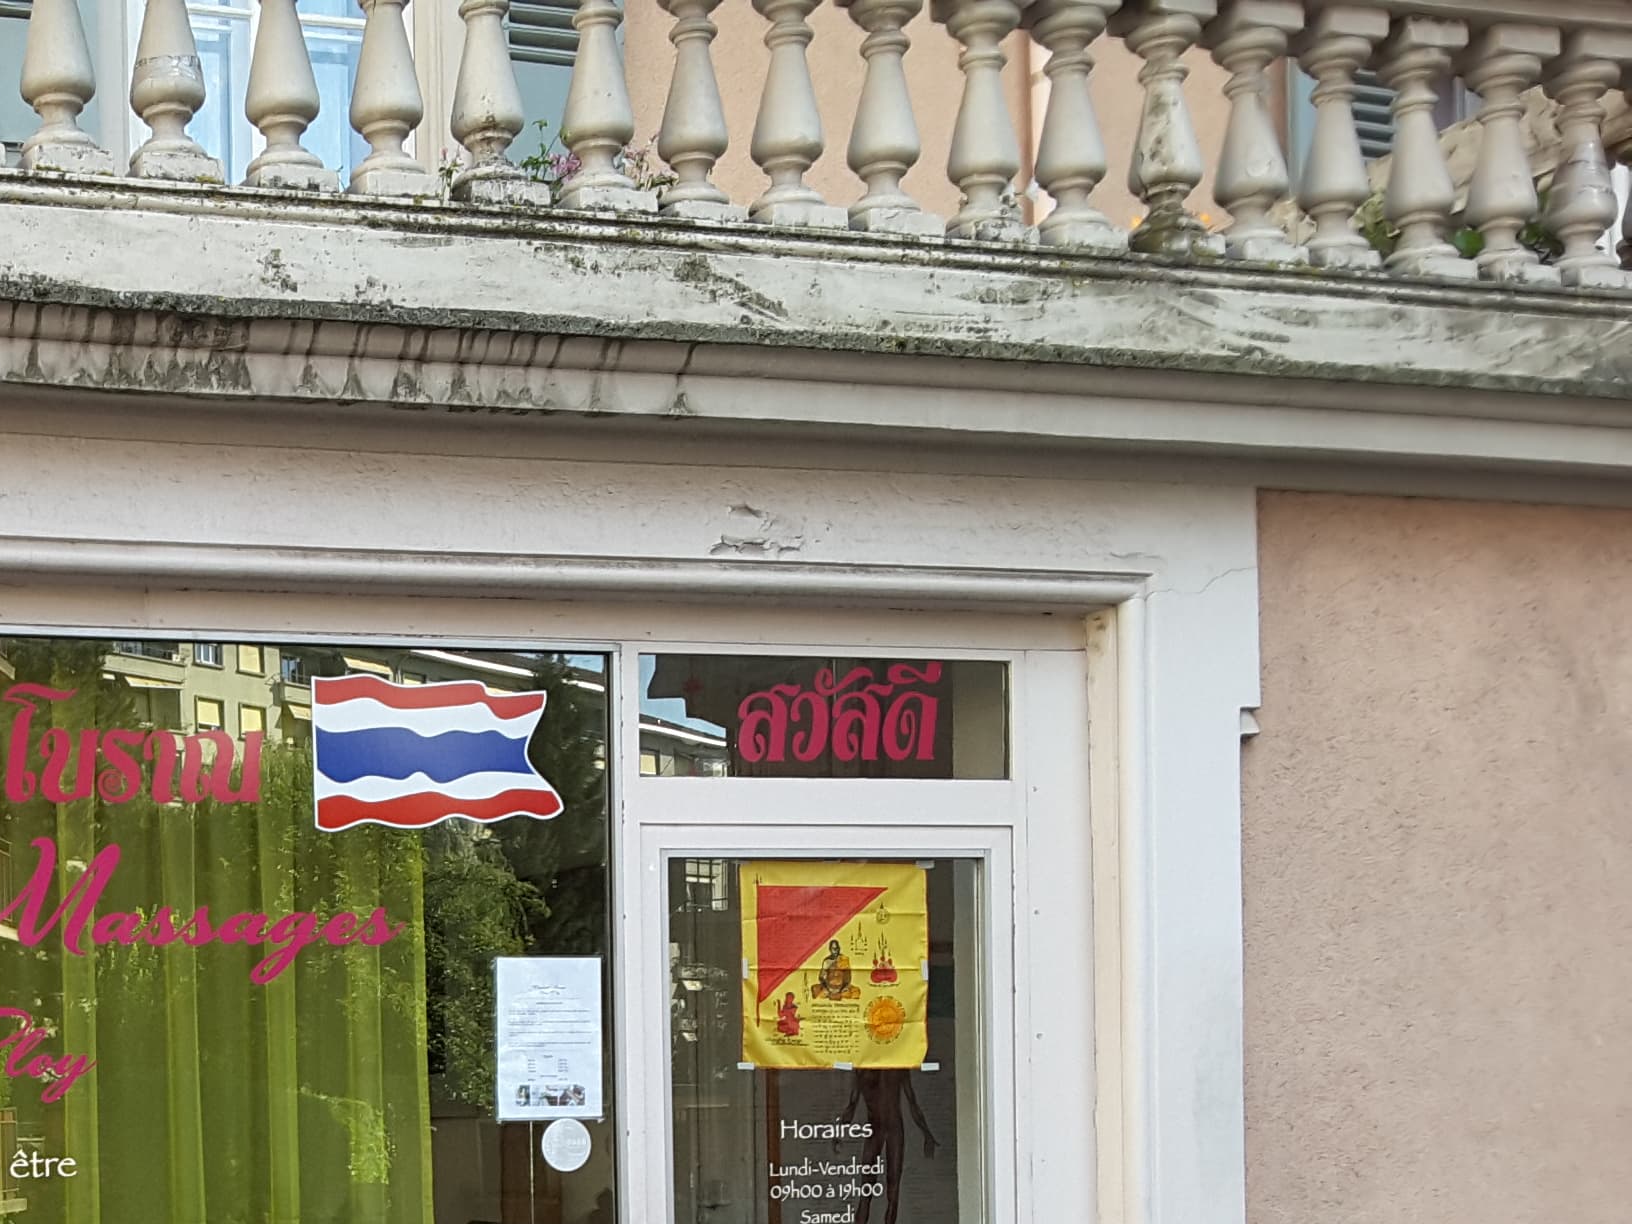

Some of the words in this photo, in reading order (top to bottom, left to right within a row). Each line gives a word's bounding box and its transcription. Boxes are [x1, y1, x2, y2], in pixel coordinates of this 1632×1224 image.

[737, 660, 942, 763] สวัสดี
[780, 1117, 873, 1139] Horaires
[9, 1149, 77, 1178] être
[769, 1156, 884, 1177] Lundi-Vendredi
[770, 1181, 823, 1202] 09h00
[825, 1185, 836, 1198] à
[839, 1179, 884, 1200] 19h00
[800, 1207, 855, 1224] Samedi
